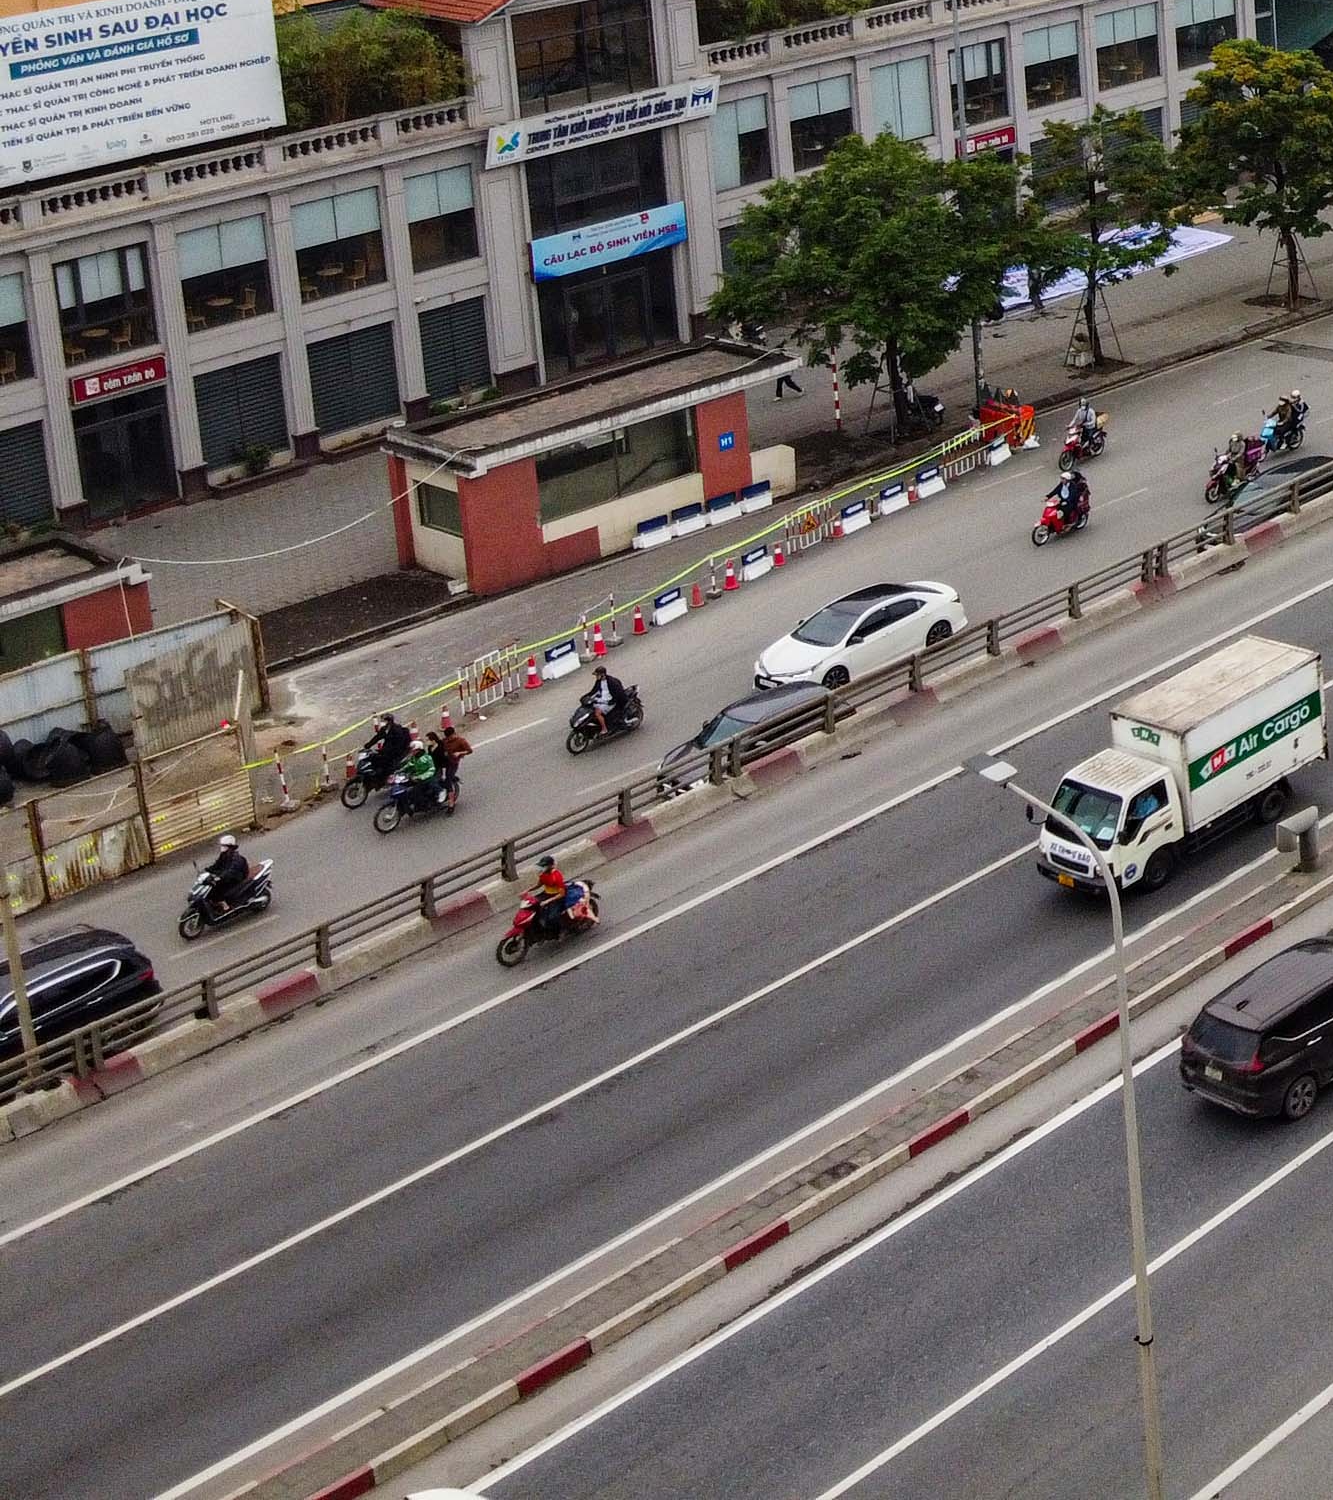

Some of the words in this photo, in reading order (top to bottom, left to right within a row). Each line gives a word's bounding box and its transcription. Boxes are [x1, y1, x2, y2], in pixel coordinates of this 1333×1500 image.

[22, 17, 55, 33] QUẢN
[58, 13, 75, 25] TRỊ
[78, 9, 93, 21] VÀ
[95, 4, 123, 18] KINH
[44, 27, 93, 49] SINH
[98, 18, 139, 39] SAU
[144, 11, 180, 31] ĐẠI
[186, 3, 228, 23] HỌC
[20, 58, 59, 74] PHỎNG
[61, 51, 84, 67] VẤN
[86, 49, 101, 62] VÀ
[103, 42, 134, 57] ĐÁNH
[136, 38, 155, 51] GIÁ
[157, 34, 173, 47] HỒ
[175, 32, 190, 44] SƠ
[80, 75, 94, 85] AN
[96, 70, 118, 81] NINH
[120, 66, 136, 76] PHI
[153, 74, 176, 85] PHÁT
[206, 62, 237, 75] DOANH
[85, 104, 107, 115] KINH
[109, 97, 142, 110] DOANH
[91, 118, 114, 129] PHÁT
[611, 125, 625, 134] AND
[543, 253, 565, 266] CÂU
[567, 247, 587, 261] LẠC
[589, 241, 605, 254] BỘ
[607, 236, 631, 249] SINH
[633, 229, 656, 242] VIÊN
[658, 223, 678, 235] HSB
[721, 436, 733, 447] H1
[1239, 733, 1259, 756] Air
[1262, 705, 1310, 740] Cargo
